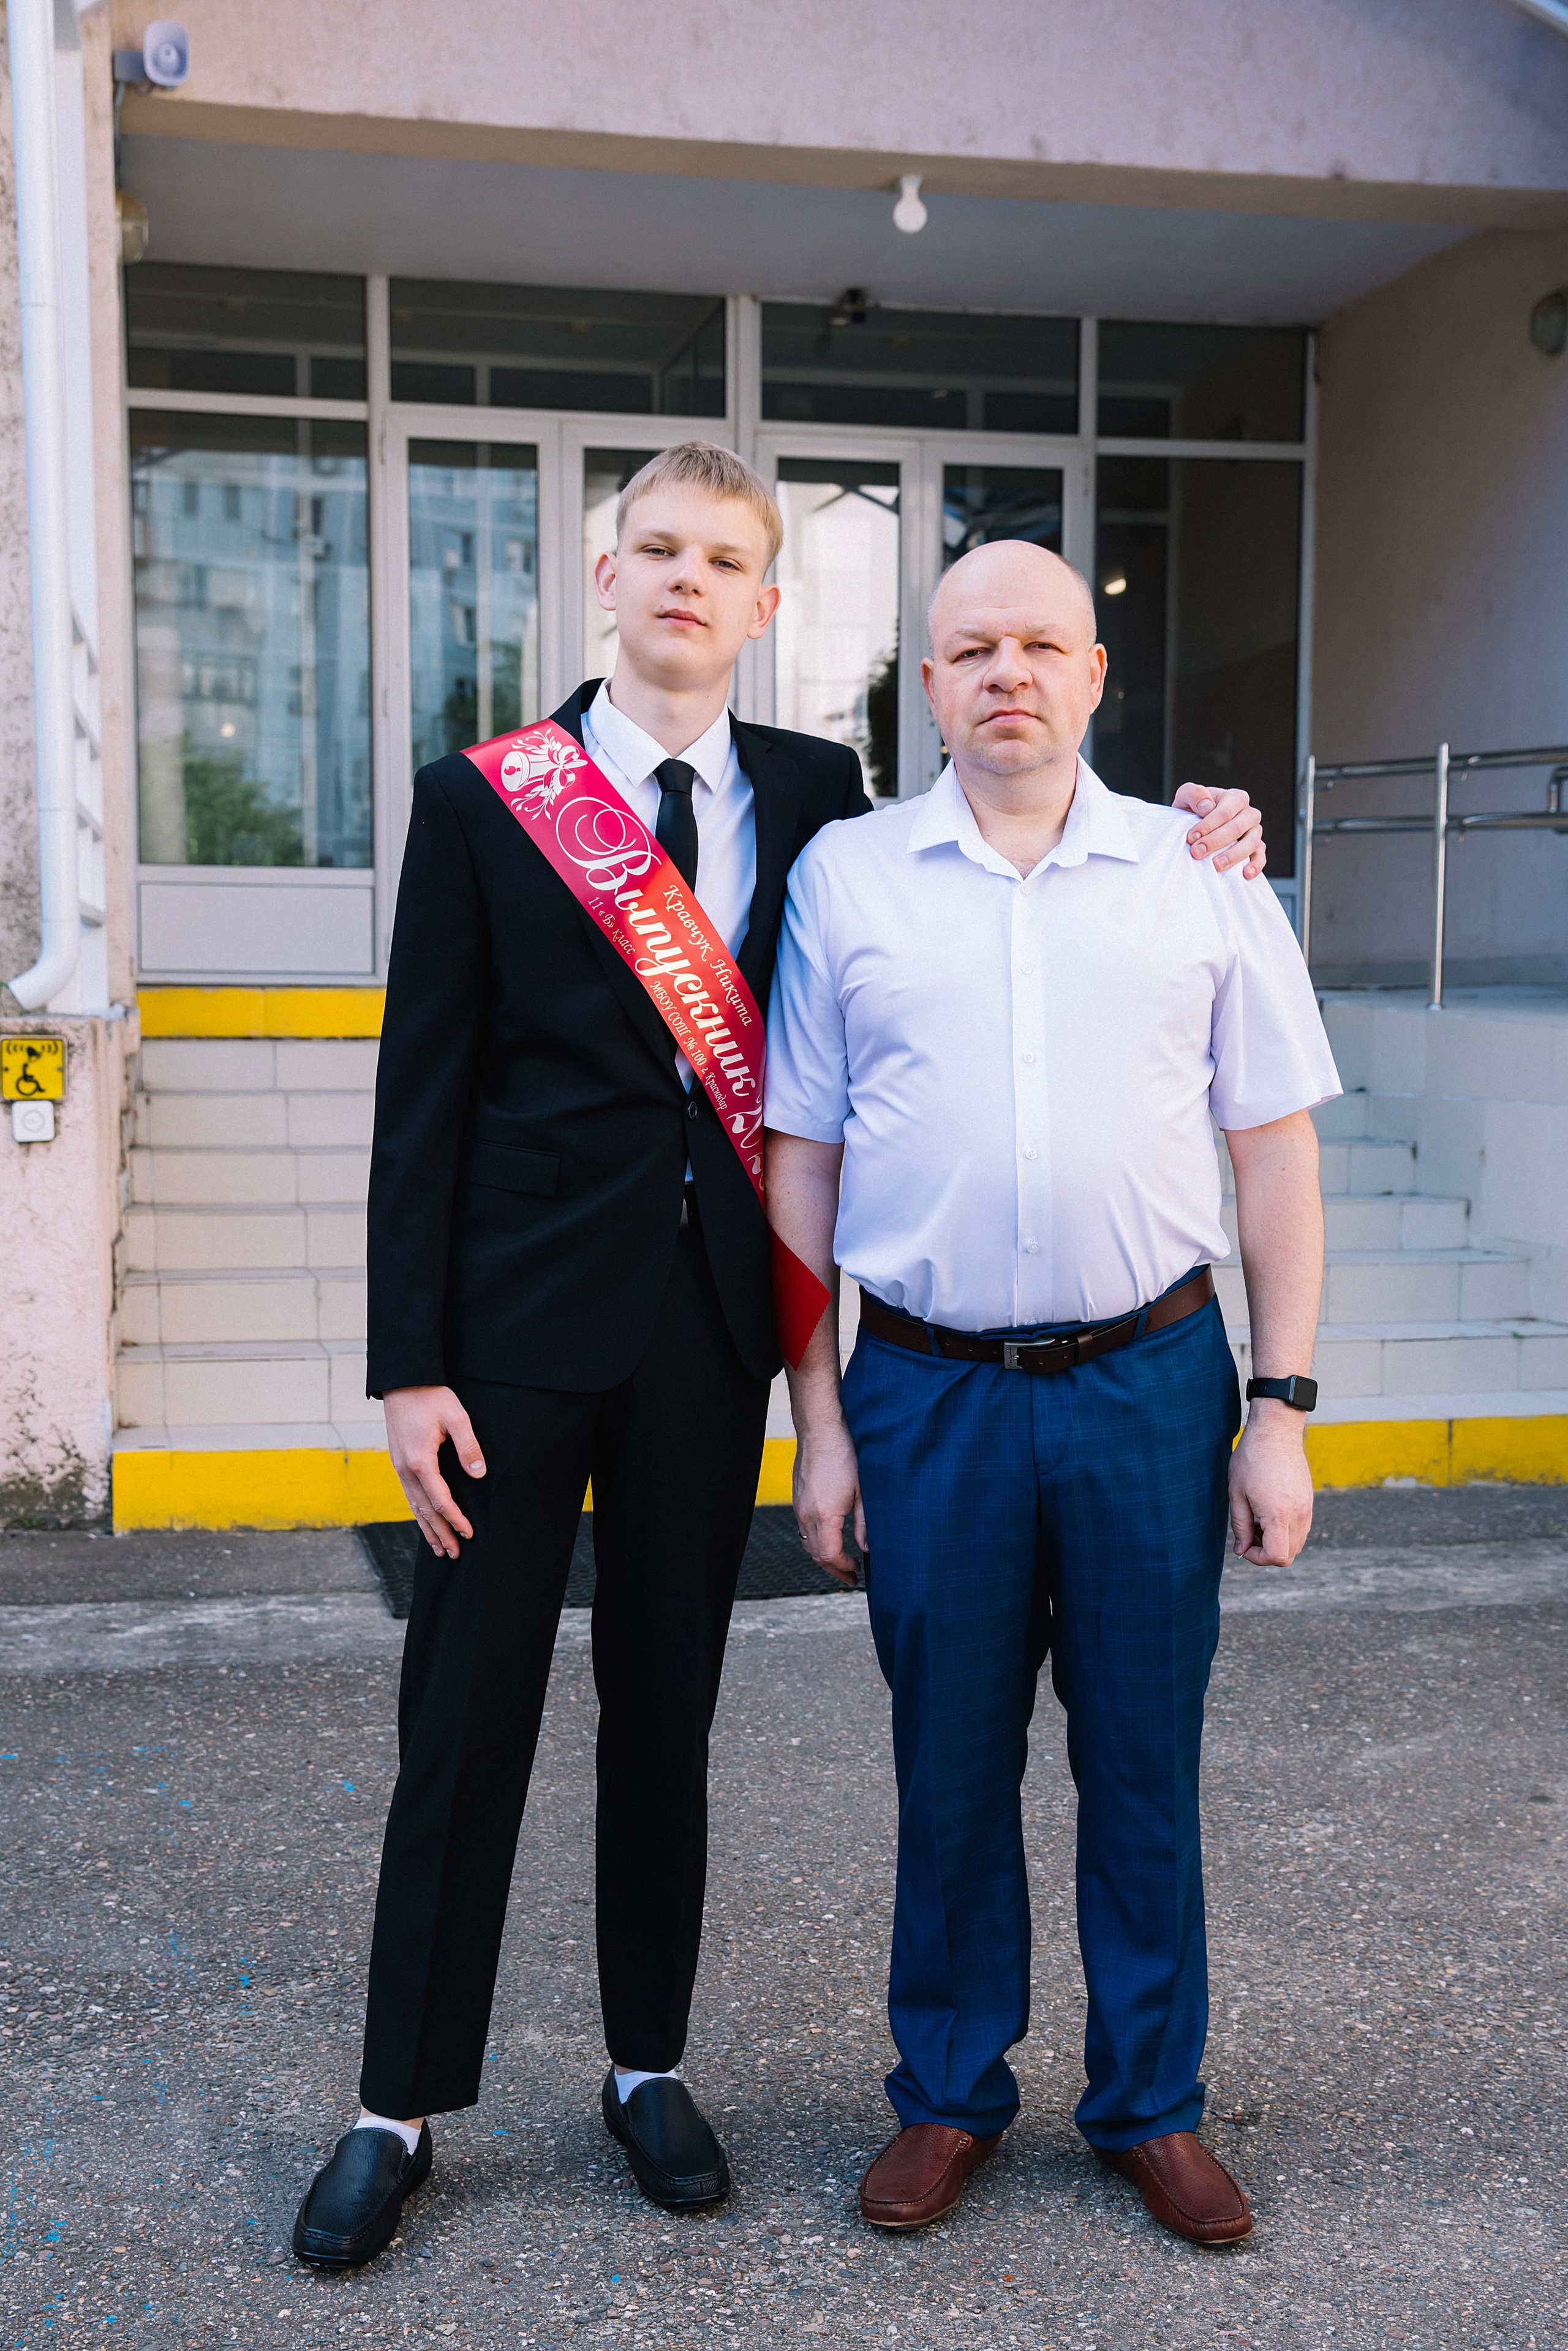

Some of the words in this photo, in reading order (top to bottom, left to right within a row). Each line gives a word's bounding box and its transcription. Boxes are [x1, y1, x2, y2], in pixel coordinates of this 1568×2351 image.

[556, 797, 756, 1096] Выпускник
[587, 897, 604, 910] 11
[612, 929, 636, 954] класс
[662, 885, 713, 962] Кравчук
[710, 959, 752, 1027] Никита
[650, 981, 677, 1011] МБОУ
[668, 1012, 691, 1036] СОШ
[683, 1037, 698, 1051] №
[691, 1049, 707, 1066] 100
[704, 1072, 727, 1111] Краснодар
